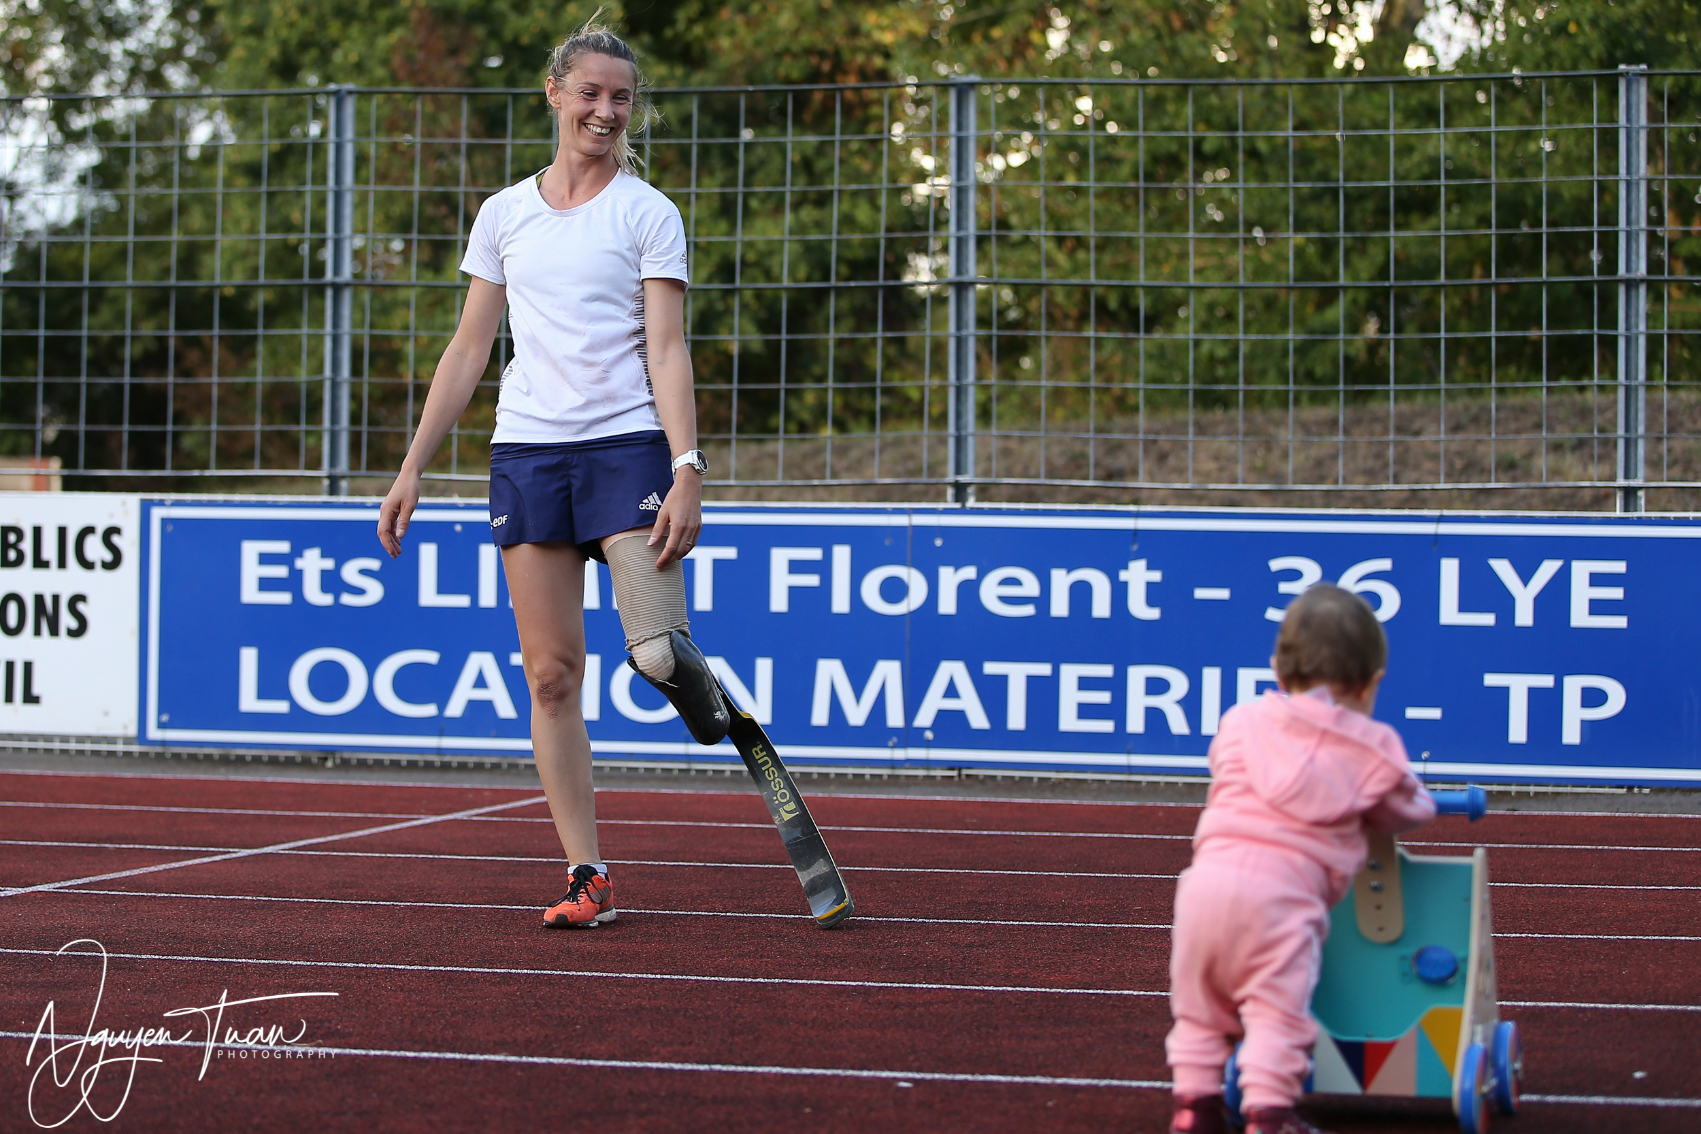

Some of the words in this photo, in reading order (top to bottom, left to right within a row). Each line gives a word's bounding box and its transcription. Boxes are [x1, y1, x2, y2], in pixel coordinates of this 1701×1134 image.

[240, 540, 385, 607] Ets
[418, 543, 737, 612] LIT
[769, 544, 1162, 620] Florent
[1264, 555, 1401, 624] 36
[1439, 557, 1628, 629] LYE
[1483, 672, 1626, 746] TP
